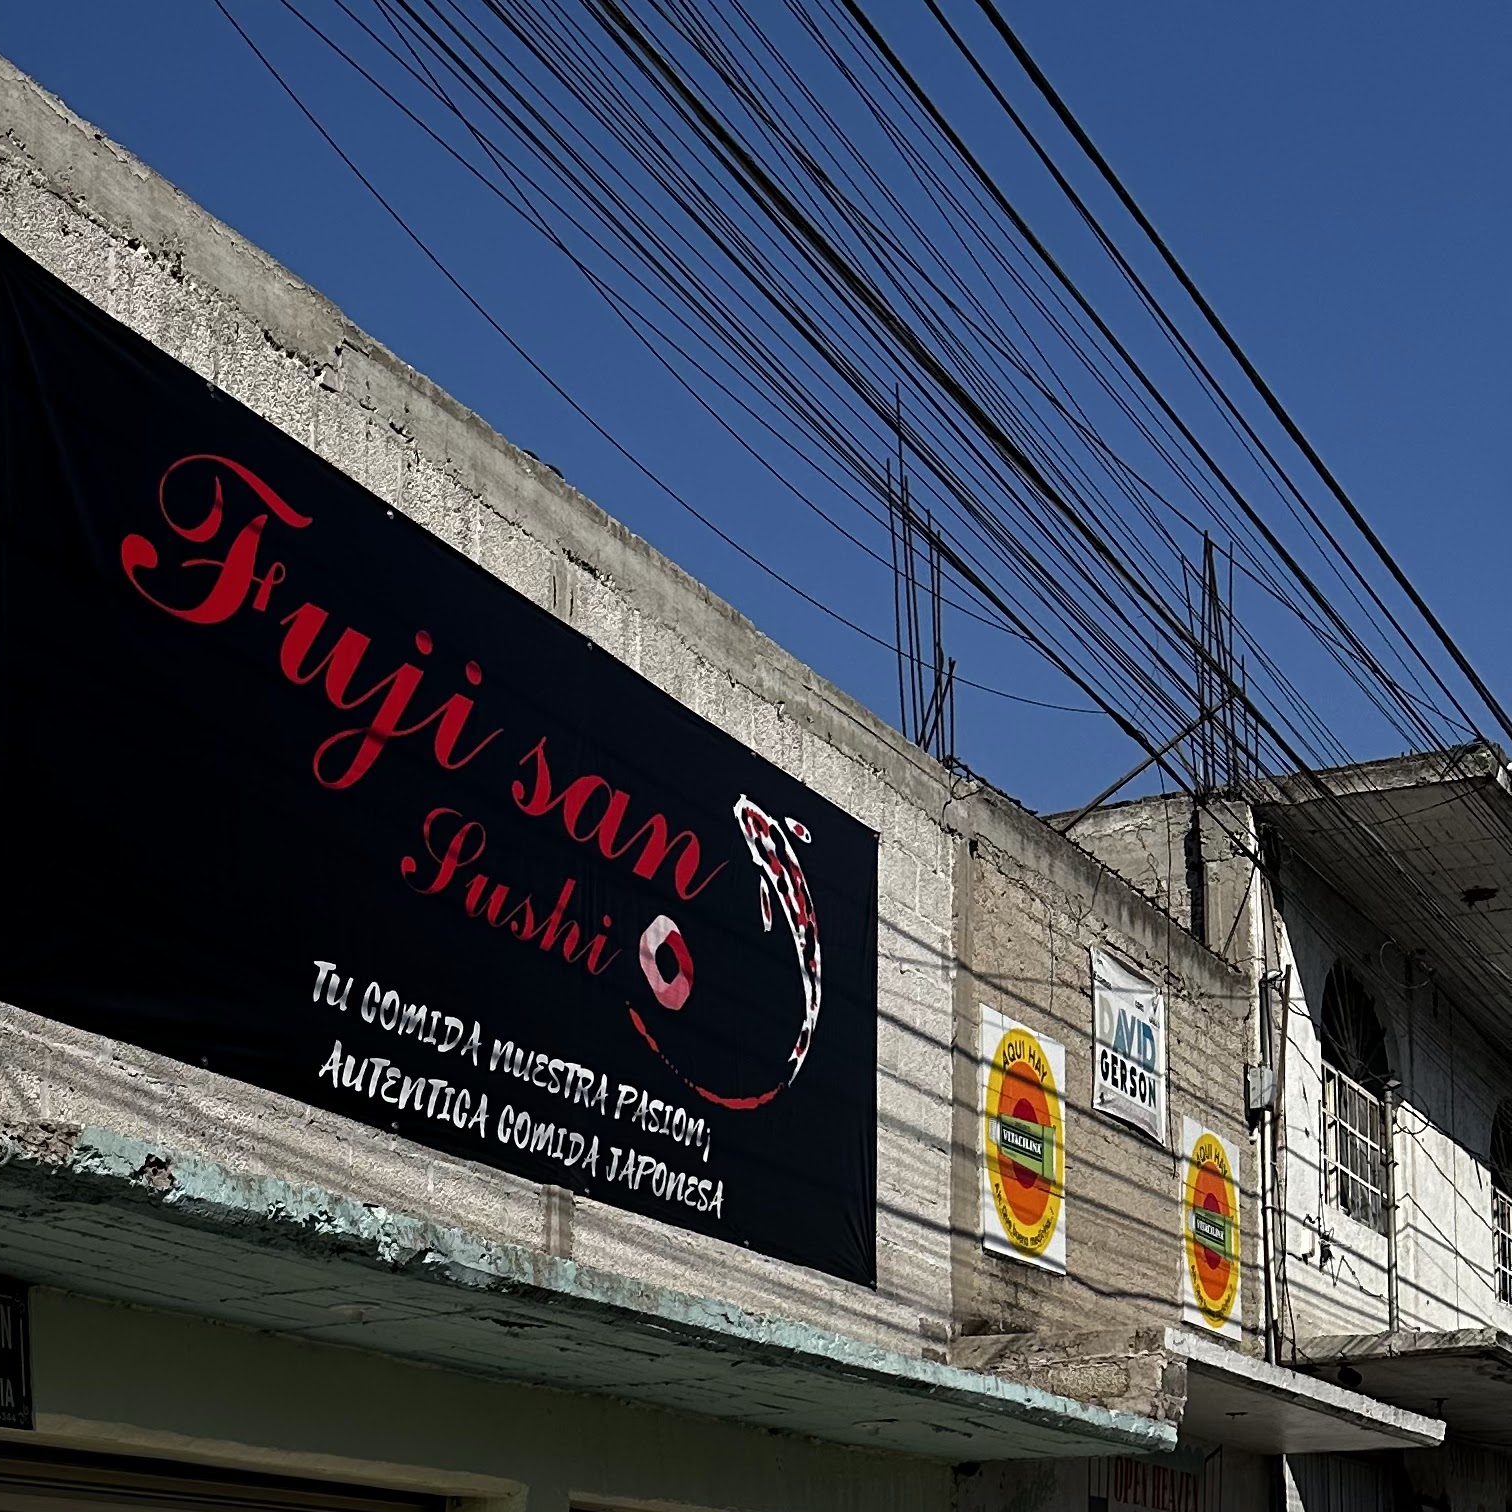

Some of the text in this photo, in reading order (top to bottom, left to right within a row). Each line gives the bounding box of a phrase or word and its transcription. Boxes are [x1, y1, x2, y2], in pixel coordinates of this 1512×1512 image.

[121, 453, 728, 899] Fuji san
[400, 807, 620, 975] Sushi
[360, 981, 483, 1066] COMIDA
[489, 1038, 610, 1117] NUESTRA
[1002, 1041, 1048, 1082] AQUI HAY
[1098, 994, 1156, 1073] DAVID
[1101, 1049, 1156, 1108] GERSON
[318, 1039, 725, 1220] AUTENTICA COMIDA JAPONESA
[1196, 1144, 1227, 1177] AQUI HAY
[1115, 1455, 1146, 1507] OPEN
